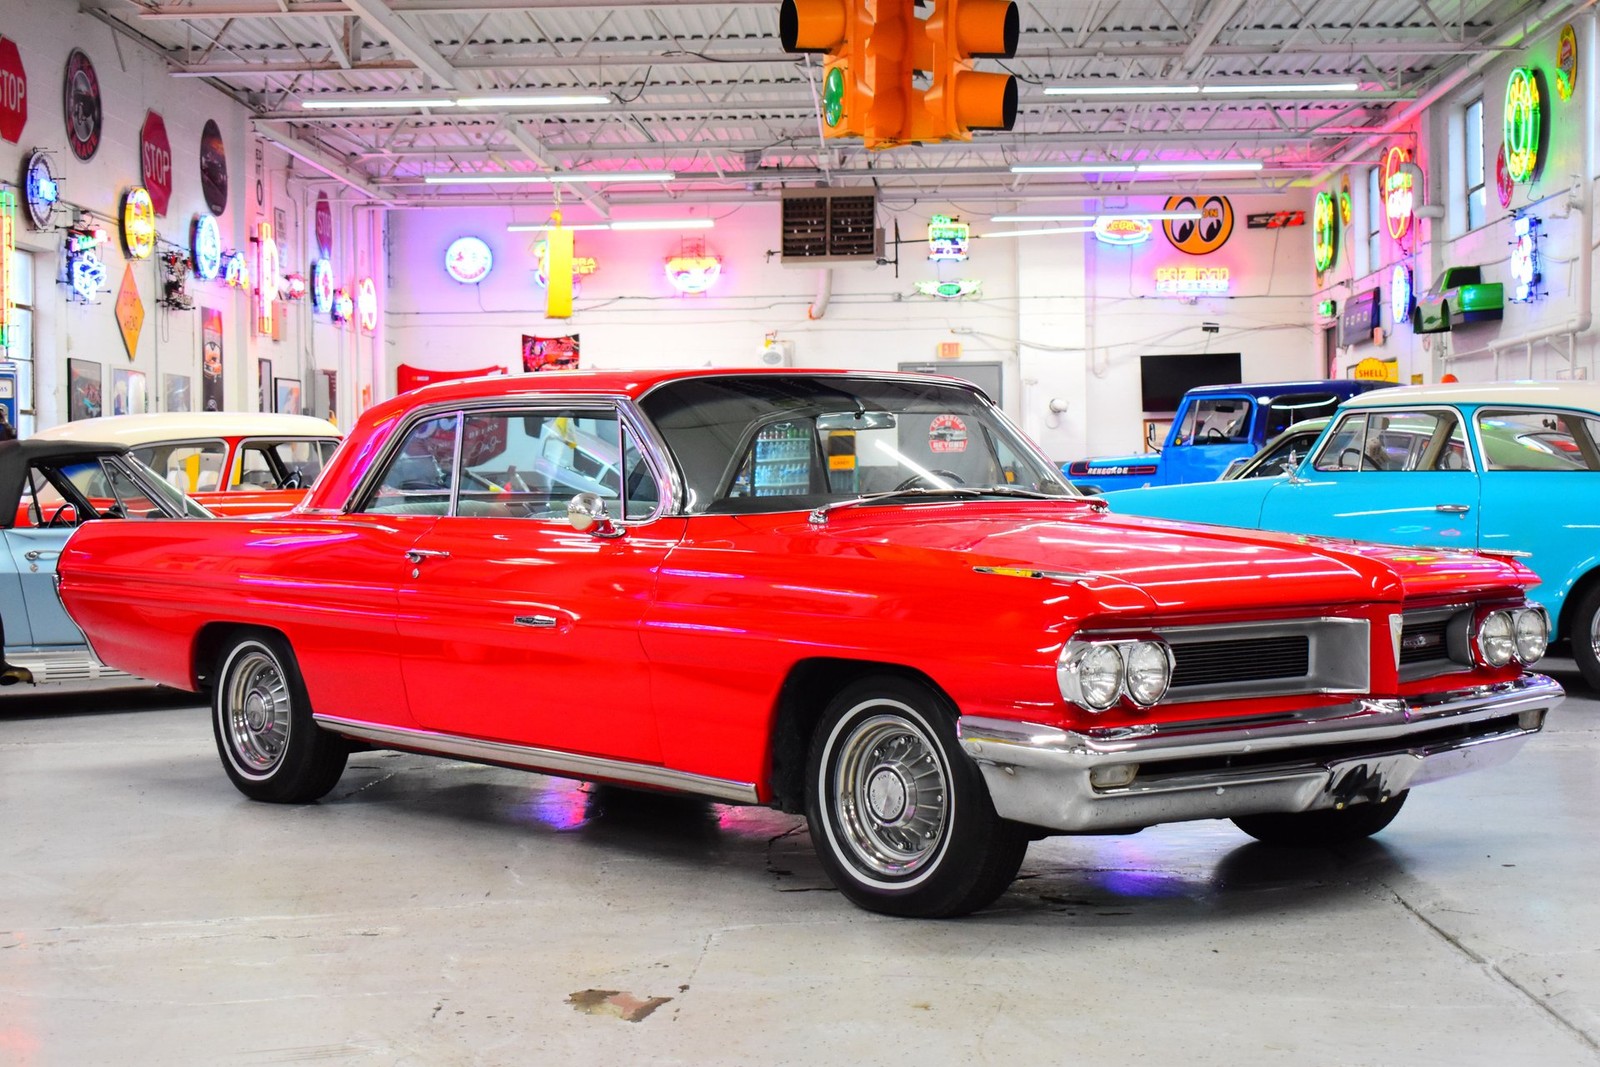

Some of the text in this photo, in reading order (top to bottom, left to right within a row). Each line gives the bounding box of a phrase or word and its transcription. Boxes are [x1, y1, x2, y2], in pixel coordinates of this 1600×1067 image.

[145, 141, 170, 187] STOP
[1345, 310, 1368, 327] FORD
[1359, 369, 1383, 378] SHELL
[1087, 466, 1129, 475] RENEGADE
